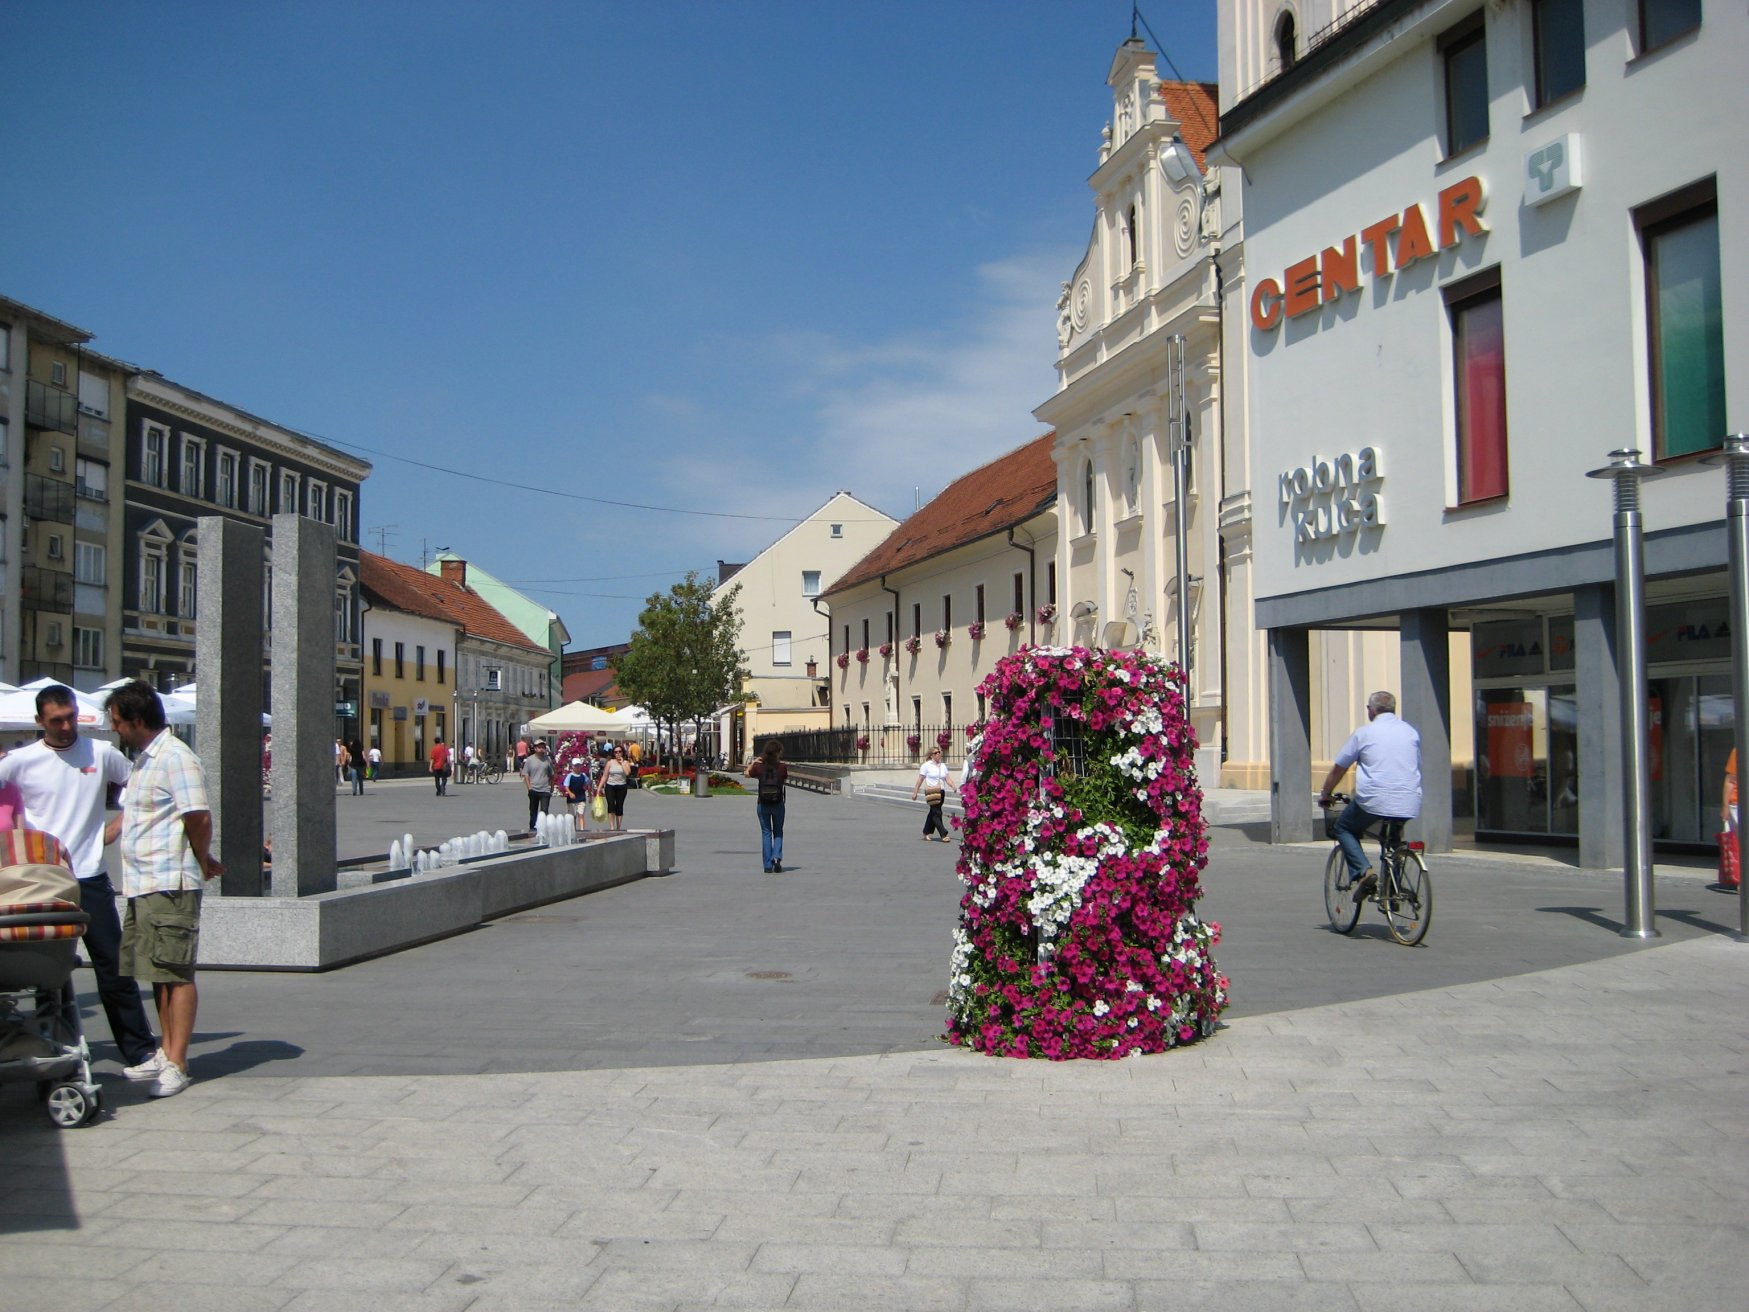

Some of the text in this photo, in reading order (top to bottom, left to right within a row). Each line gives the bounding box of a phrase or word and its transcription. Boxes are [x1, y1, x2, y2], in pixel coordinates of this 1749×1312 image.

[1251, 176, 1490, 330] CENTAR
[1278, 447, 1384, 503] robna
[1677, 623, 1711, 641] FILA
